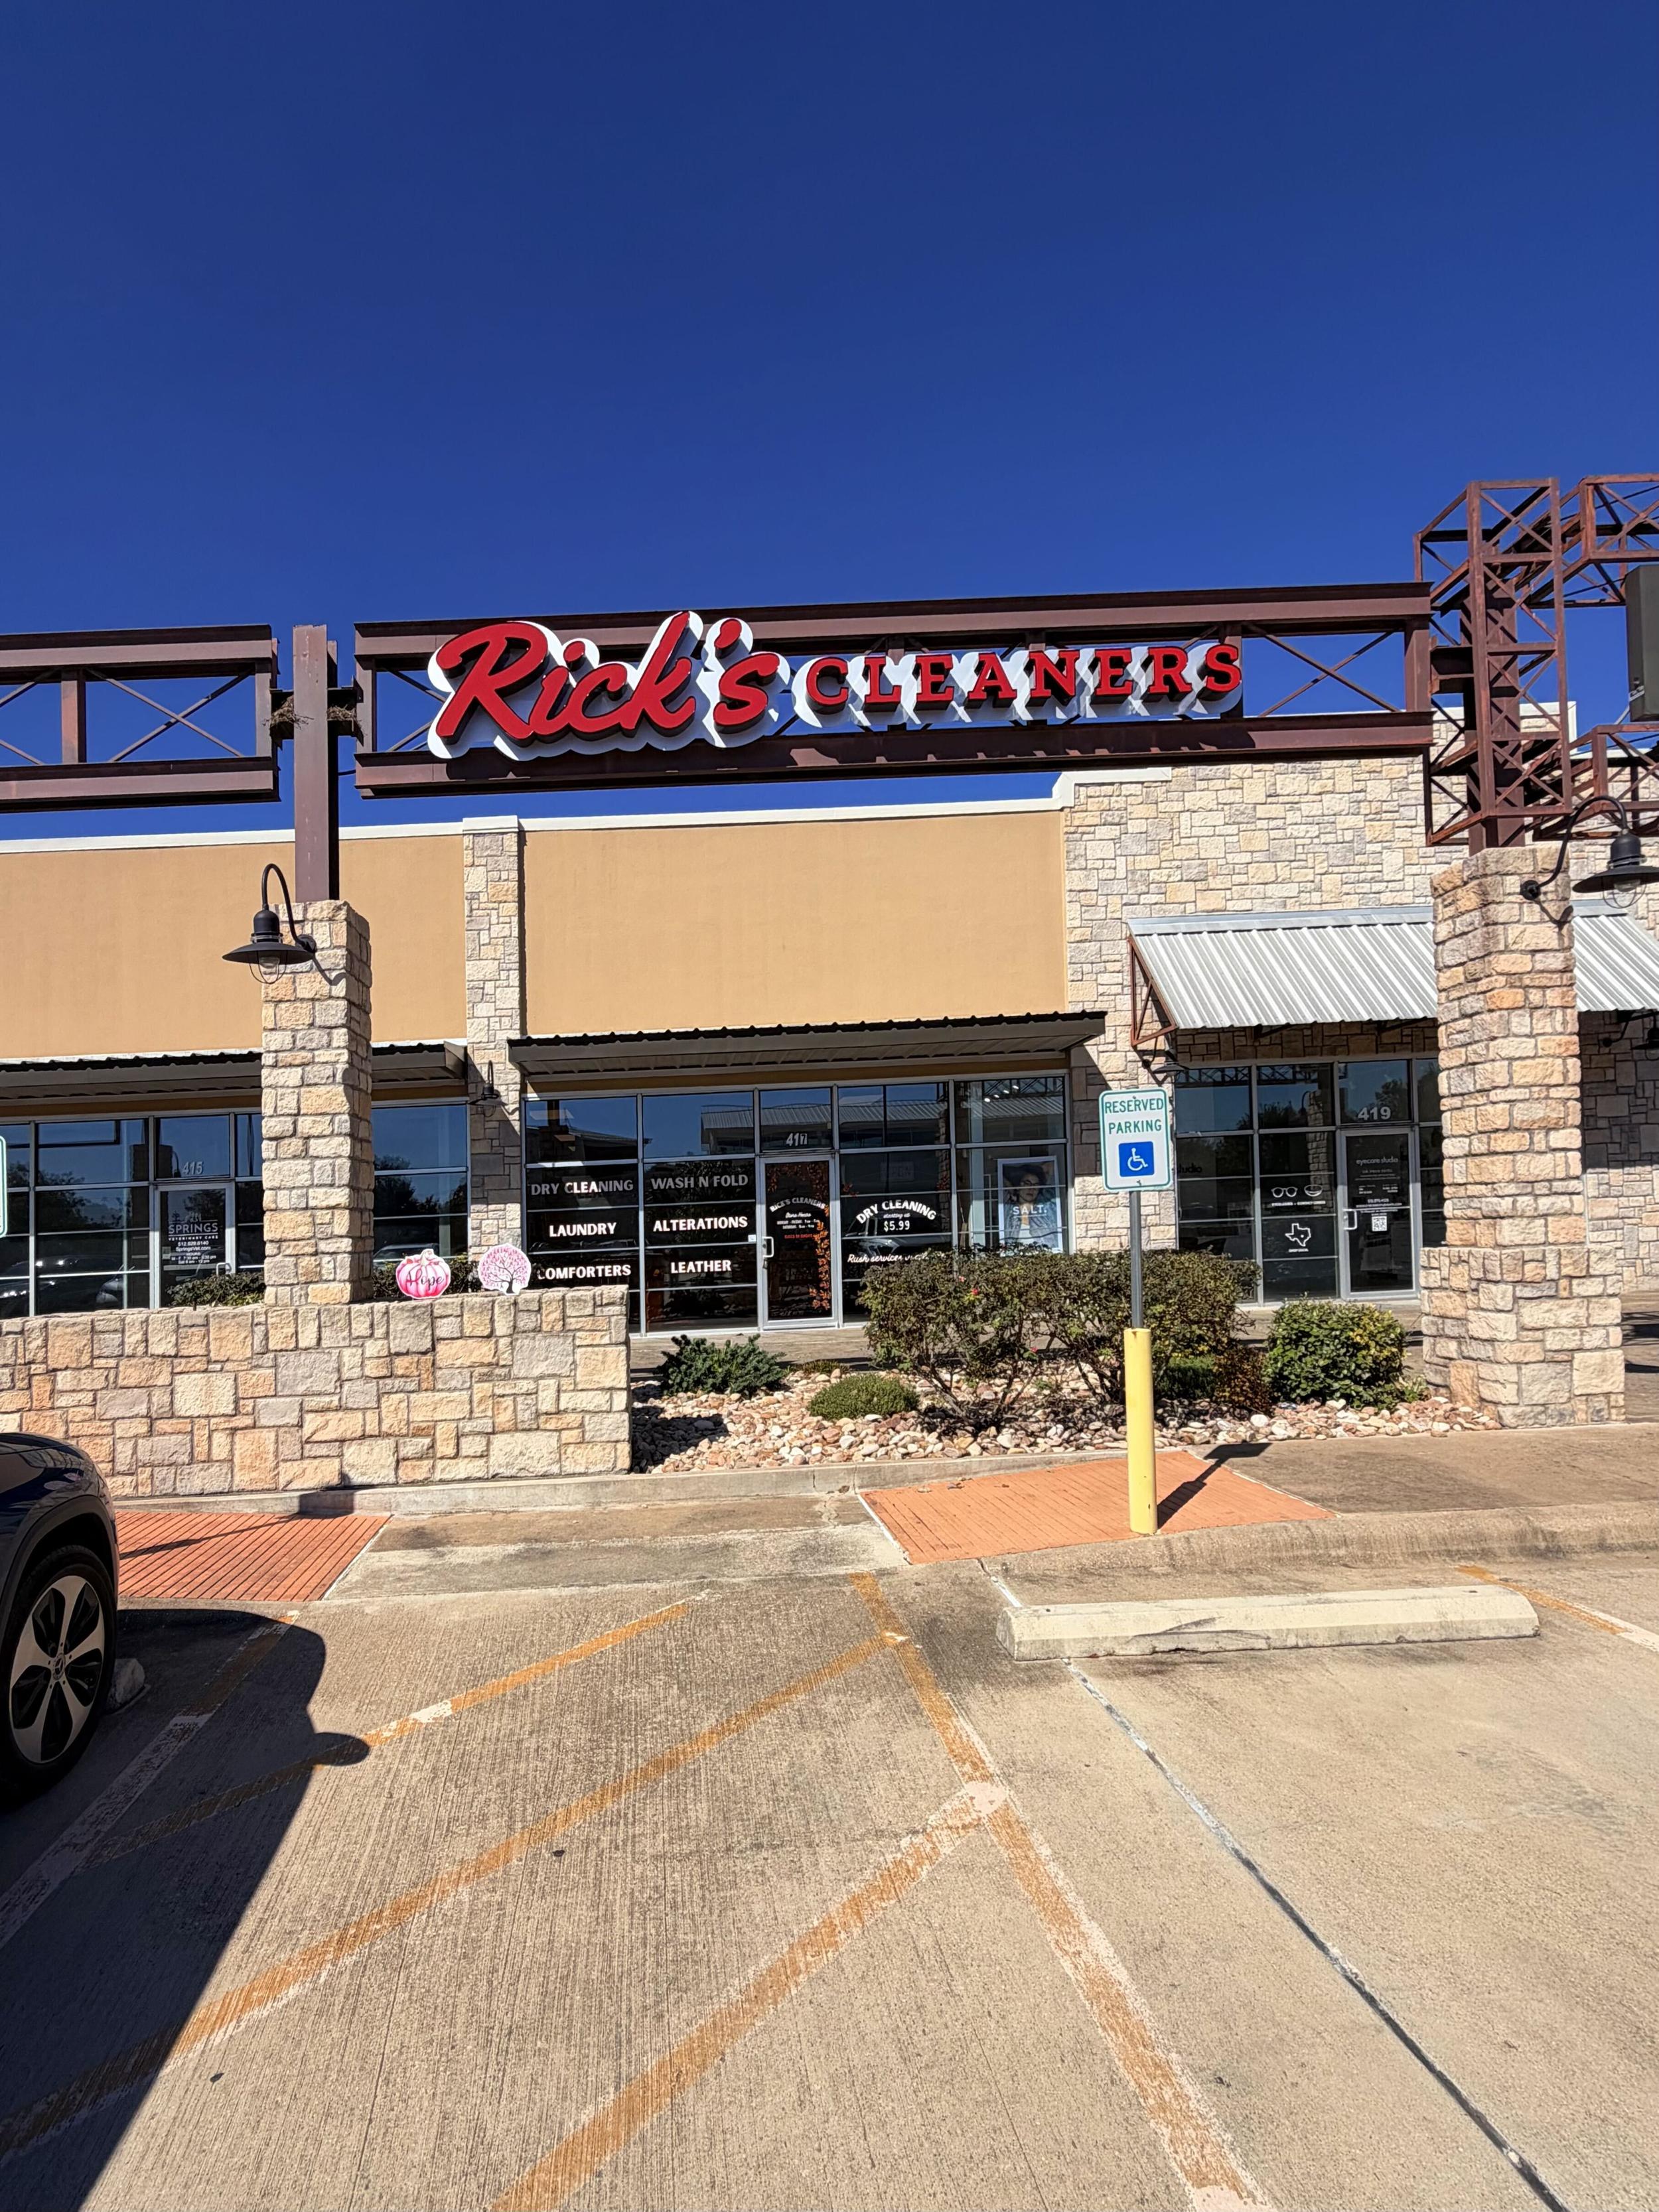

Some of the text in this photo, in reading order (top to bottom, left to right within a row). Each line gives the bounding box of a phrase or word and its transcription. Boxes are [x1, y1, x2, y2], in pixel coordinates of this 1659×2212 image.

[435, 611, 1243, 742] Rick's CLEANERS
[1105, 1098, 1164, 1113] RESERVED
[1358, 1107, 1391, 1121] 419
[1109, 1119, 1162, 1135] PARKING
[786, 1133, 808, 1146] 417
[182, 1161, 203, 1174] 415
[531, 1180, 634, 1196] DRY CLEANING
[651, 1174, 749, 1190] WASH N FOLD
[856, 1200, 937, 1224] DRY CLEANING
[1013, 1204, 1047, 1215] SALT.
[168, 1223, 218, 1234] SPRINGS
[549, 1222, 616, 1237] LAUNDRY
[653, 1217, 748, 1232] ALTERATIONS
[883, 1220, 910, 1232] $5.99
[847, 1253, 870, 1263] Rush
[671, 1260, 731, 1274] LEATHER
[406, 1268, 445, 1291] Hope
